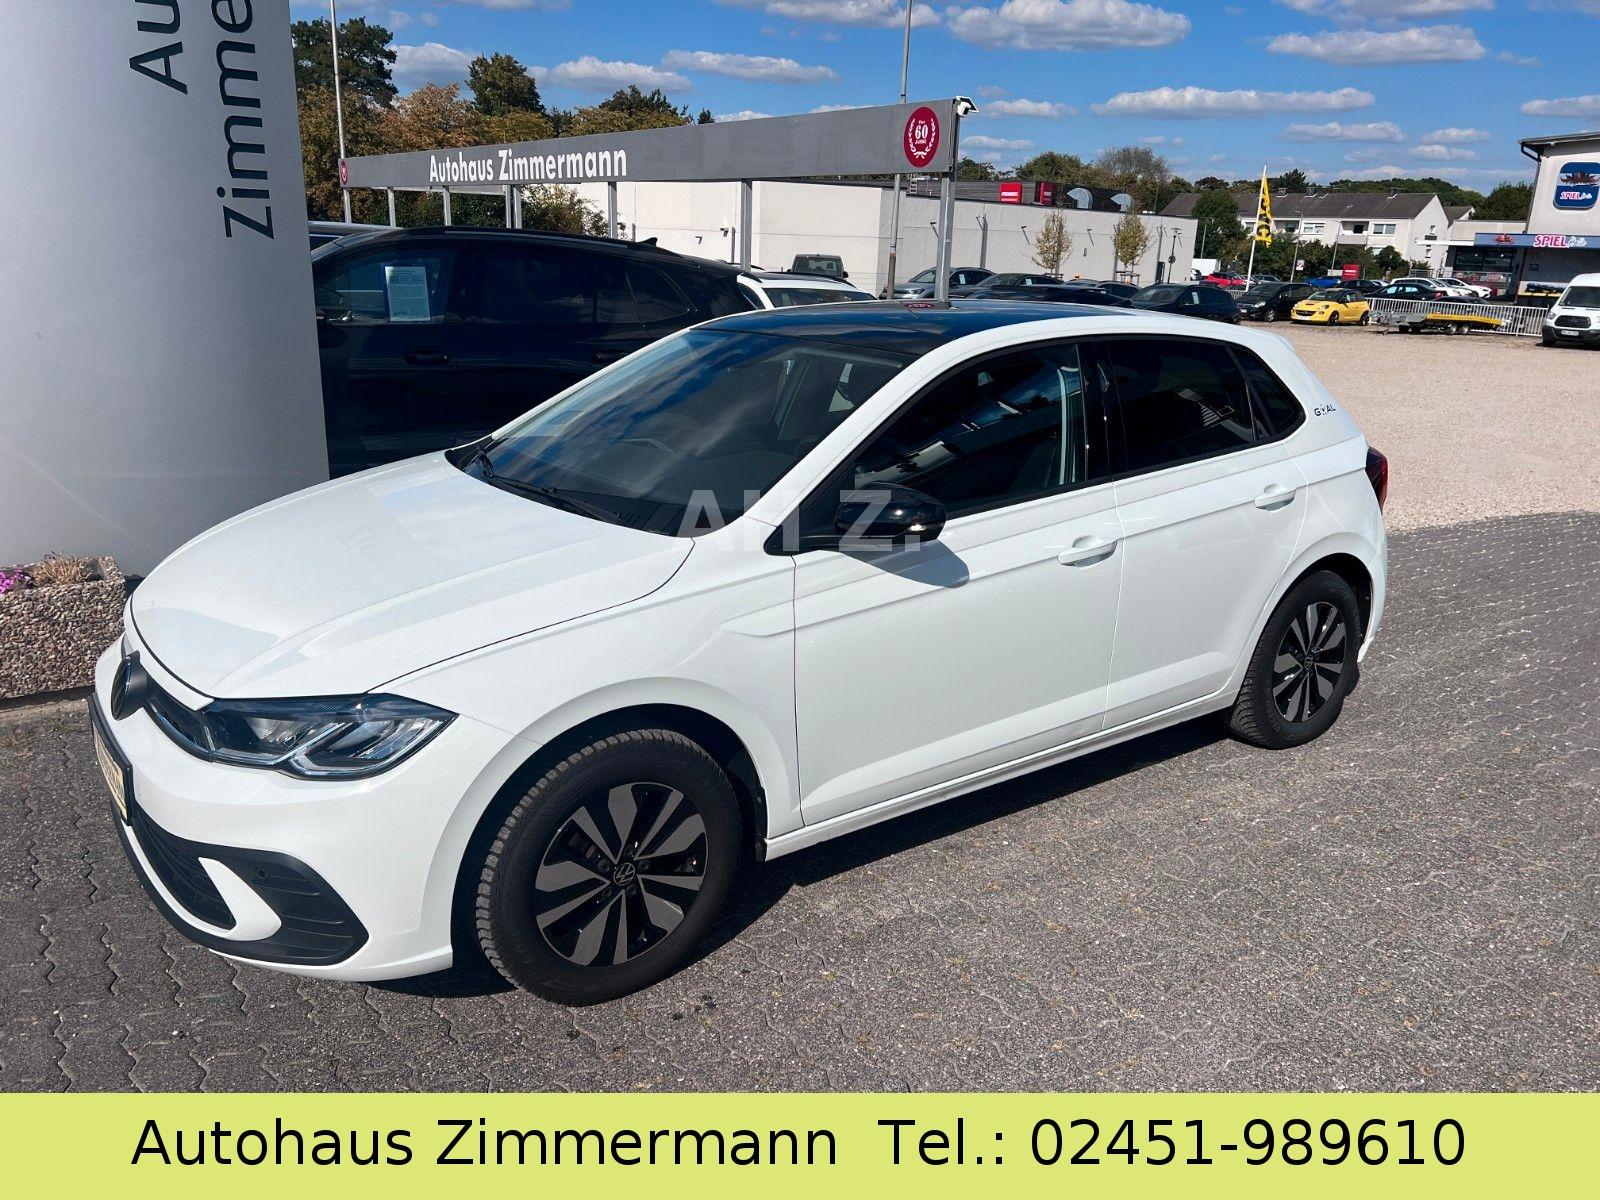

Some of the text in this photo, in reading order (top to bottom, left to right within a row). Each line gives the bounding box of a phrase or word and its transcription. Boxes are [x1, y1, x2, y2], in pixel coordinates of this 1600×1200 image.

[915, 124, 928, 140] 60
[429, 148, 627, 183] Autohaus Zimmermann
[1534, 234, 1567, 248] SPIEL
